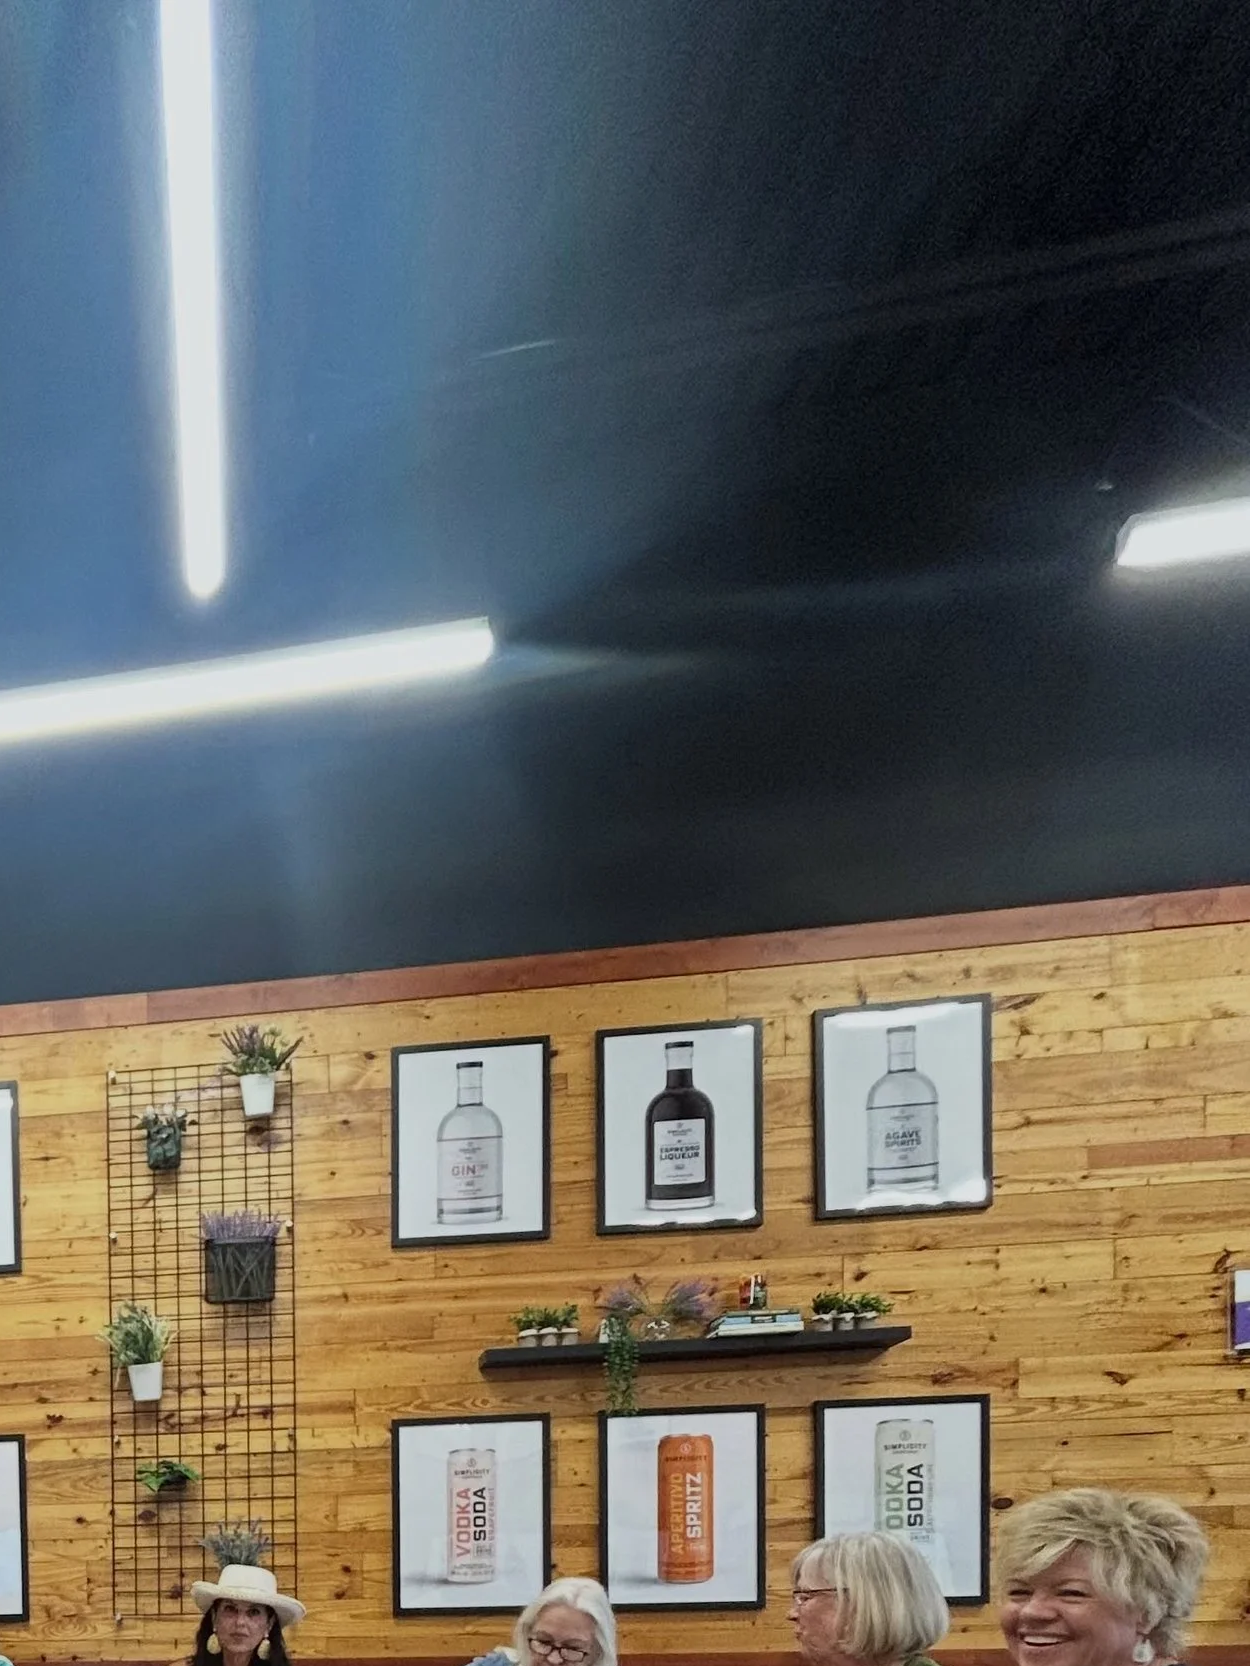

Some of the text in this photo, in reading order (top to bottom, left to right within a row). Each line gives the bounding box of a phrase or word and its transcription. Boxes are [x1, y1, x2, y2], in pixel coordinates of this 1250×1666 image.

[451, 1164, 476, 1177] GIN
[456, 1487, 471, 1558] VODKA
[473, 1486, 487, 1541] SODA
[685, 1472, 702, 1539] SPRITZ
[885, 1463, 905, 1530] ODKA
[907, 1463, 924, 1527] SODA
